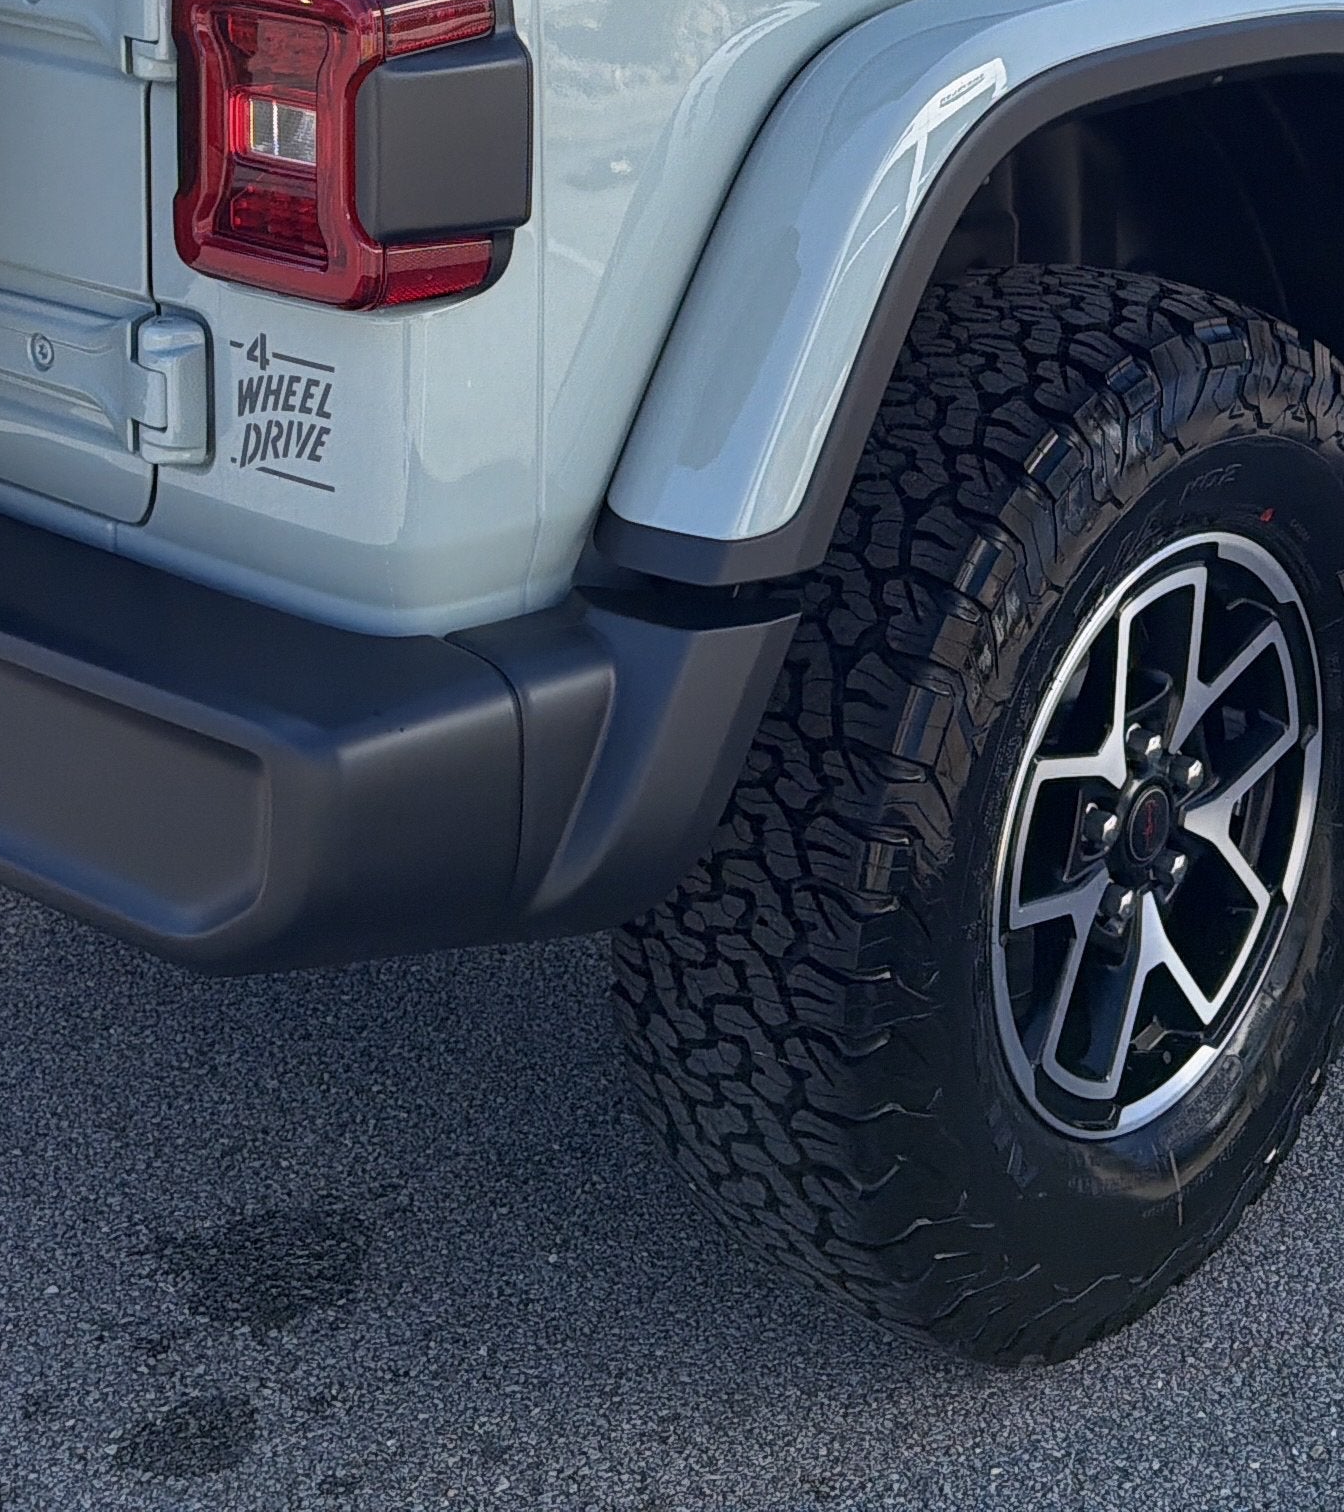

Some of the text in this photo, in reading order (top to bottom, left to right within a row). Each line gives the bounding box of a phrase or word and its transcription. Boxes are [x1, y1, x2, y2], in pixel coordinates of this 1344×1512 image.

[246, 332, 270, 371] 4
[237, 374, 332, 419] WHEEL
[239, 419, 332, 469] DRIVE
